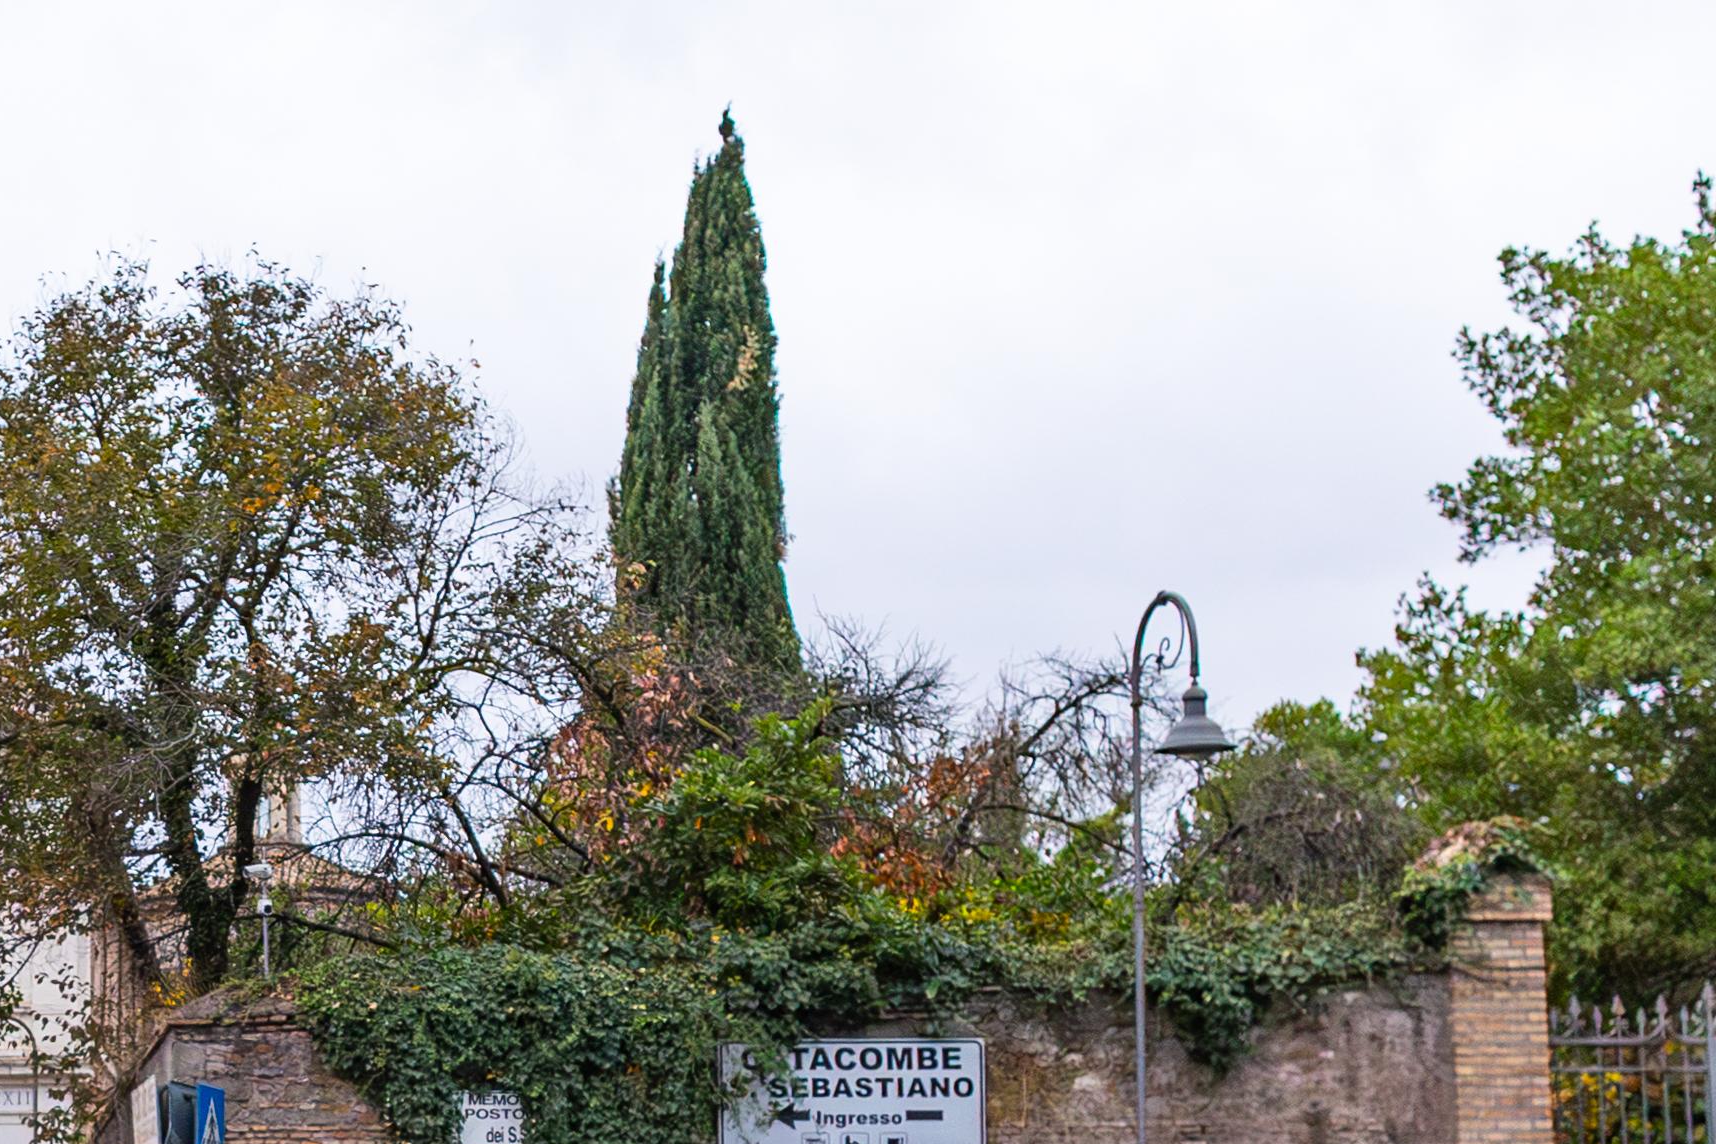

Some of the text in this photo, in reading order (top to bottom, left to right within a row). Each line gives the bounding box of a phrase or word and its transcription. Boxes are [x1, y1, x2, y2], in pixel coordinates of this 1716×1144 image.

[740, 1046, 962, 1071] CTACOMBE
[768, 1076, 974, 1099] SEBASTIANO
[468, 1093, 520, 1106] MEMO
[815, 1110, 903, 1129] Ingresso
[486, 1126, 504, 1143] dei
